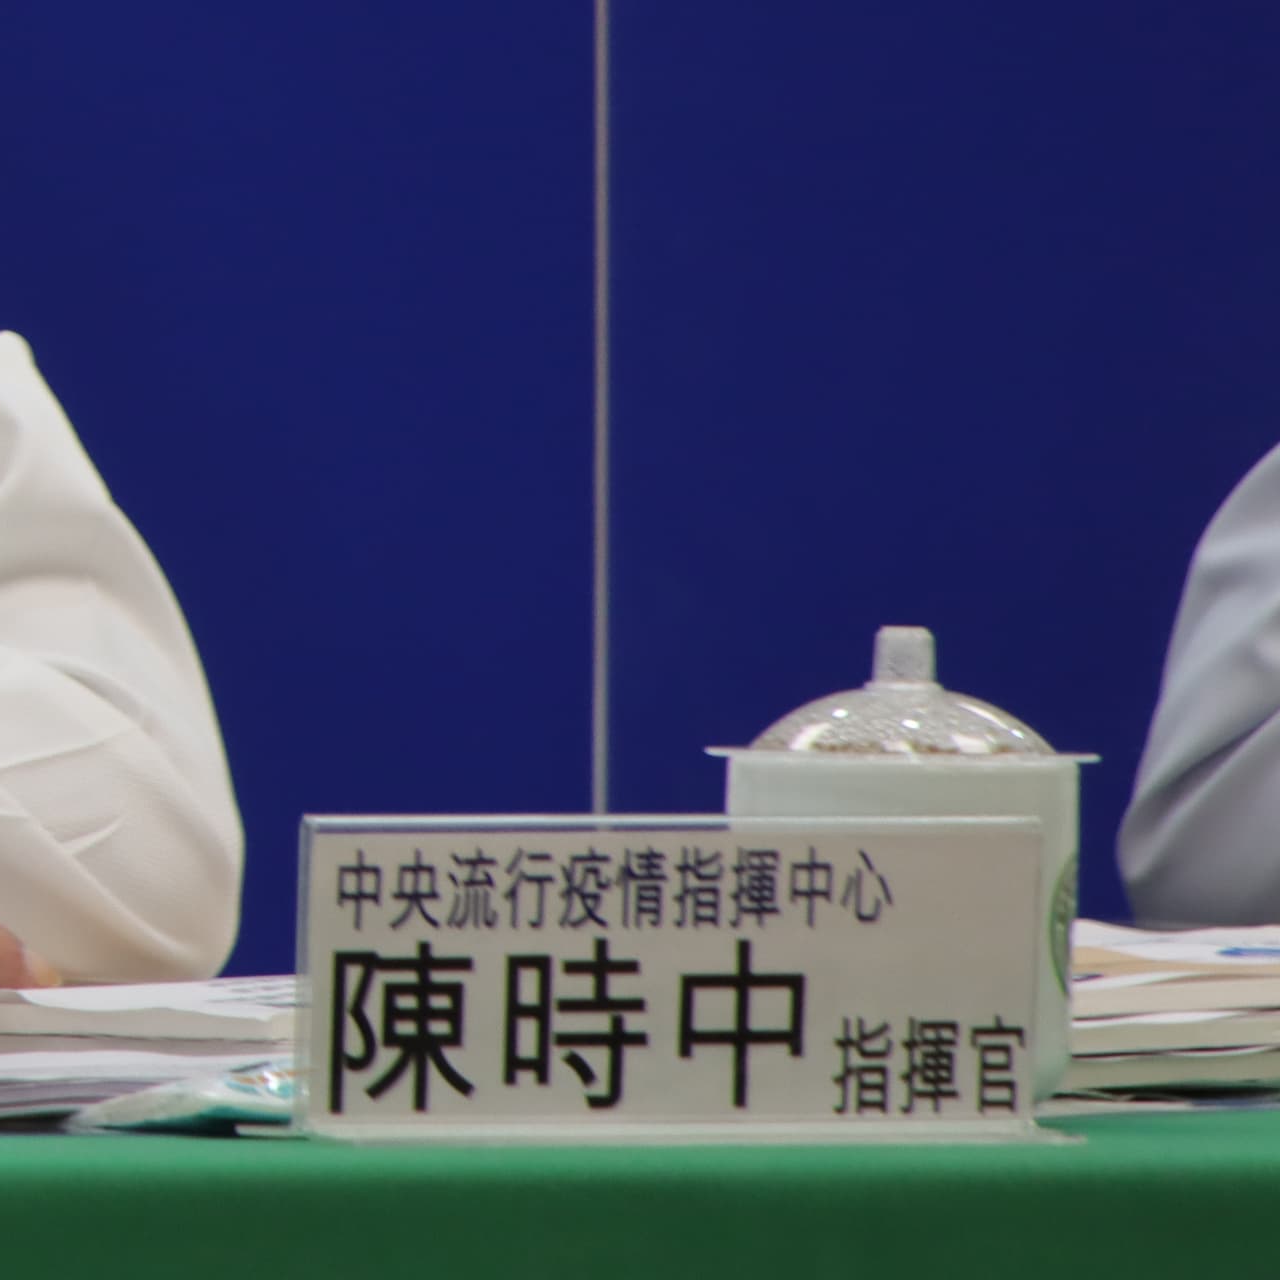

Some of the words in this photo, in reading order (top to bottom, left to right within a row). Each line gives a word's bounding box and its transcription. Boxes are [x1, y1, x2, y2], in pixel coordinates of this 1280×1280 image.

[336, 846, 894, 932] 中央流行疫情指揮中心
[328, 936, 807, 1115] 陳時中
[832, 1015, 1027, 1116] 指揮官
